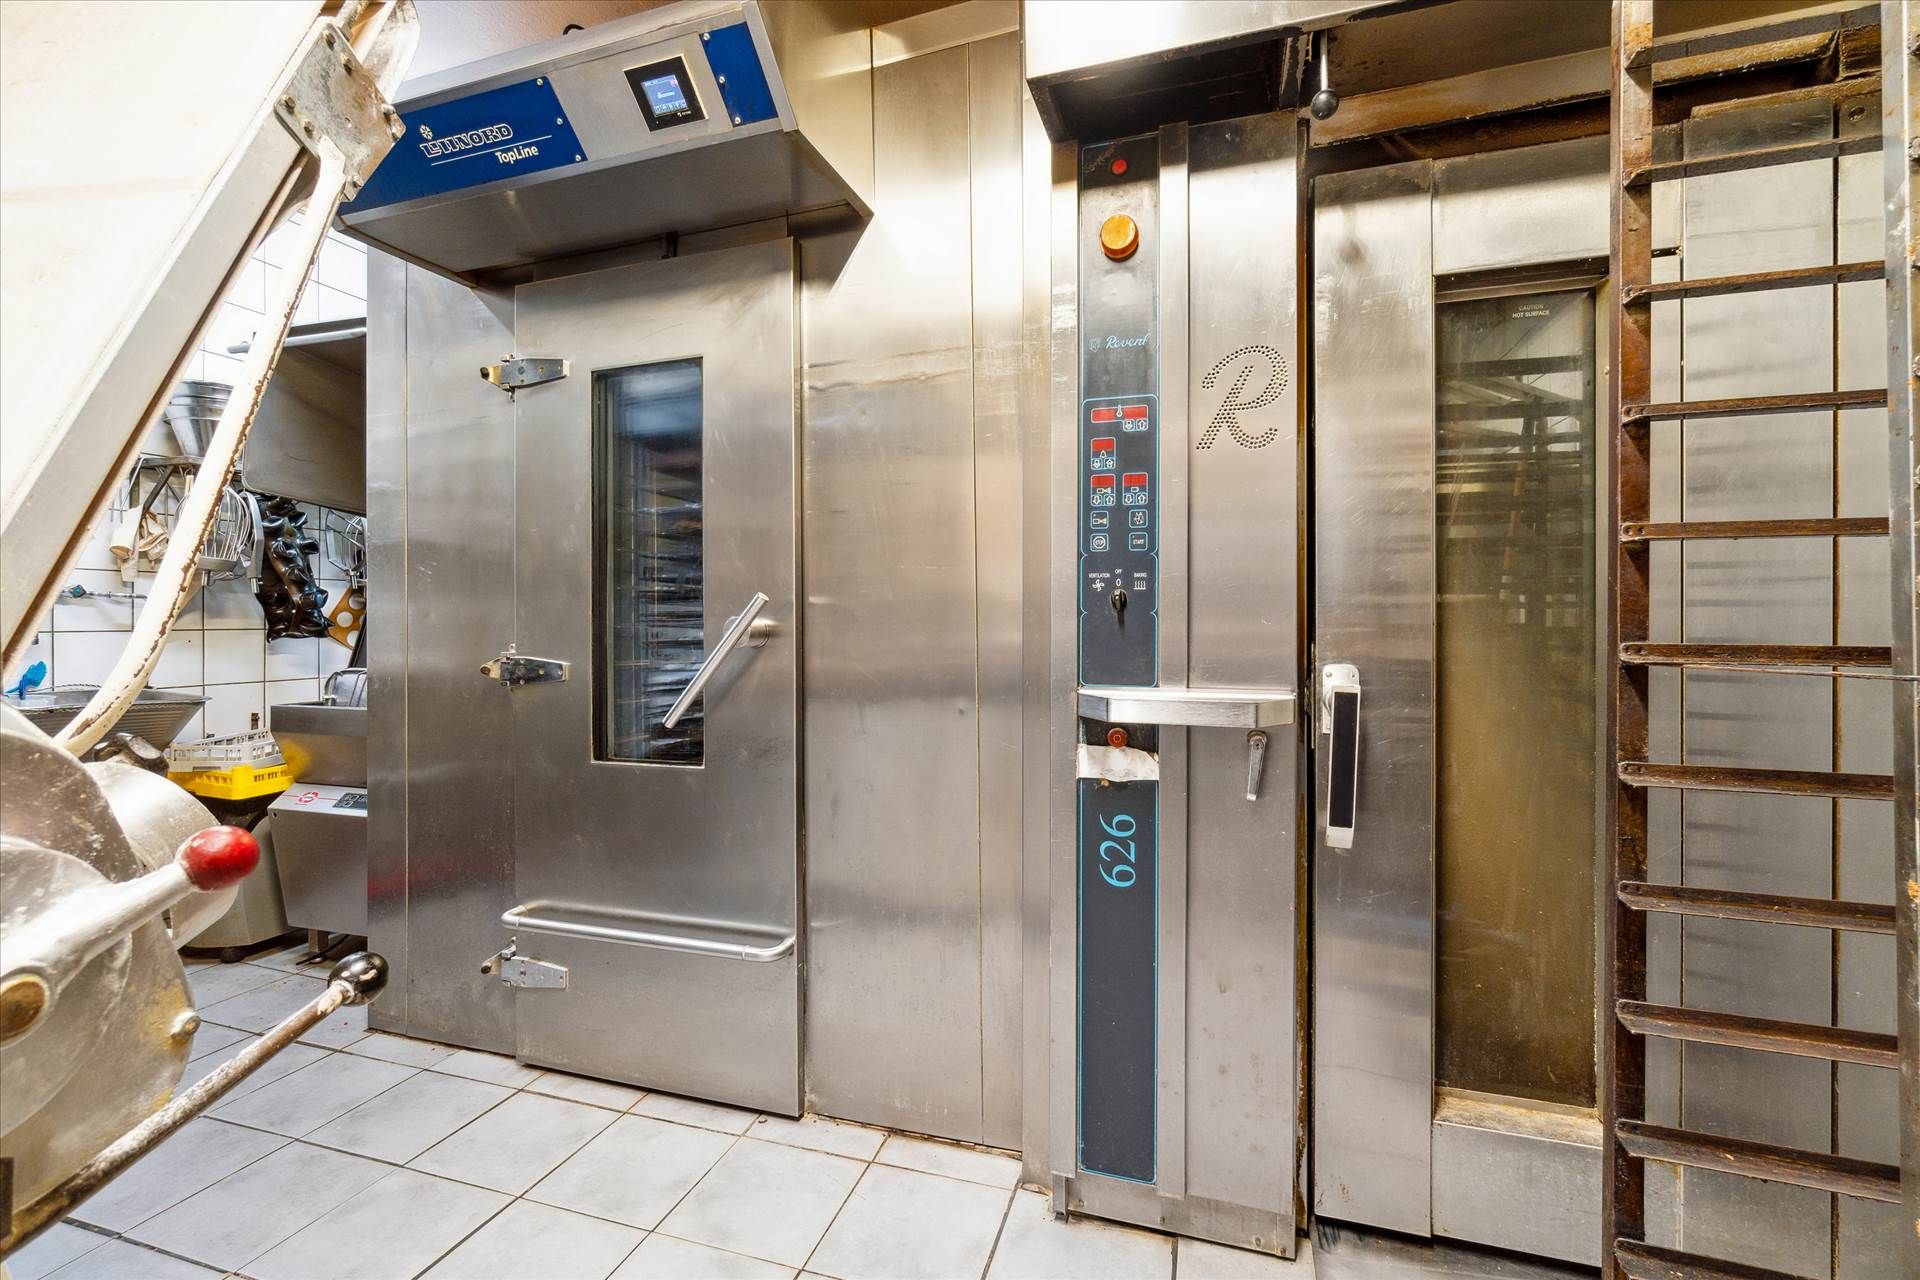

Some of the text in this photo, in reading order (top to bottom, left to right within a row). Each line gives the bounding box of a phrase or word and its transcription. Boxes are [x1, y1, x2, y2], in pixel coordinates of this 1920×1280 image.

[495, 145, 539, 164] TopLine
[1195, 345, 1288, 450] R
[1099, 813, 1137, 888] 626
